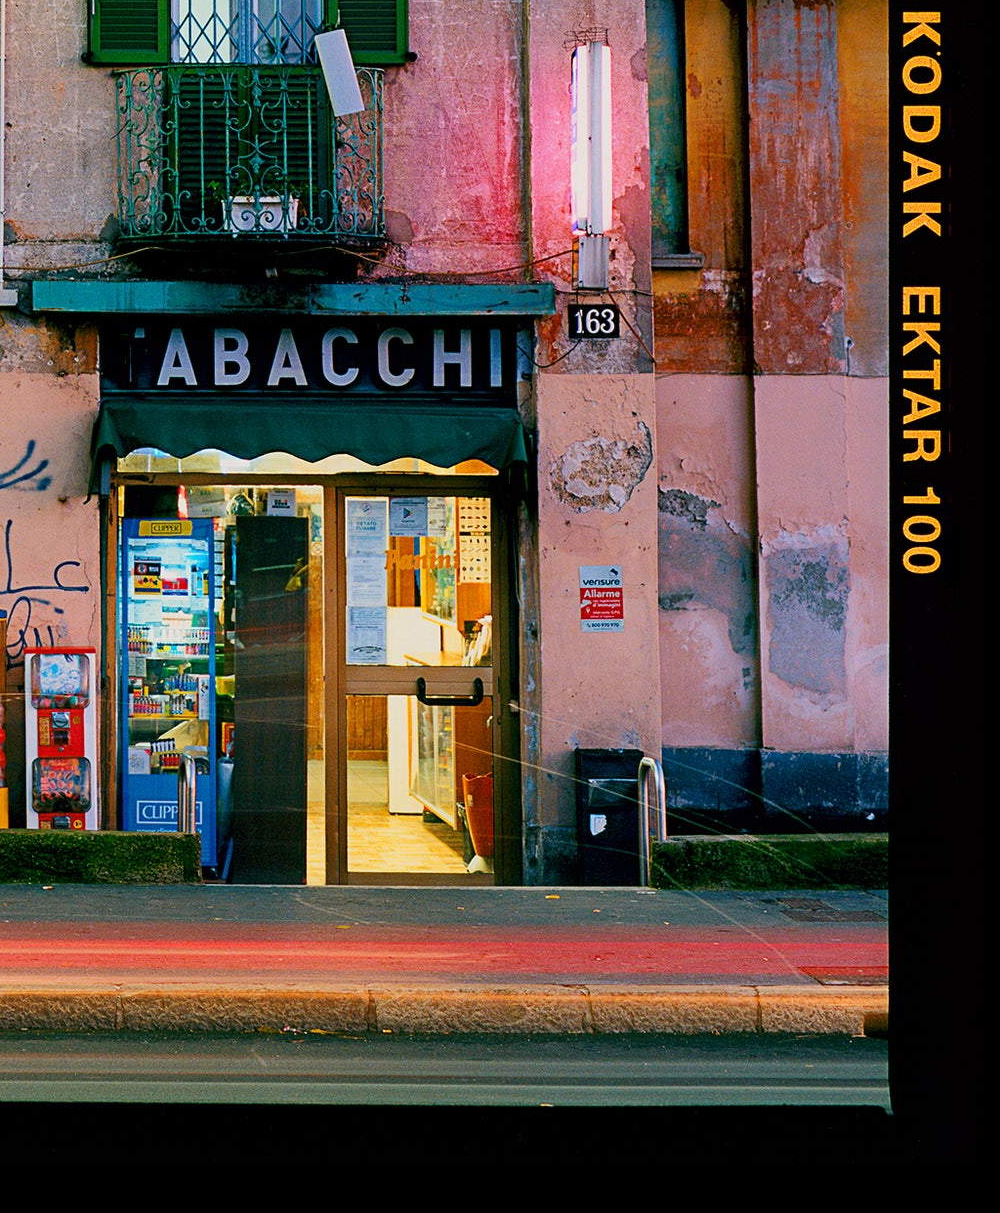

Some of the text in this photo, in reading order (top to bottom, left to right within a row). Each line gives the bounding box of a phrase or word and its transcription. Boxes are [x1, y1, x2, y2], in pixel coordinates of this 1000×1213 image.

[574, 308, 616, 334] 163
[134, 327, 502, 387] ABACCHI
[584, 589, 621, 598] Allarme
[142, 804, 199, 819] CLIPP
